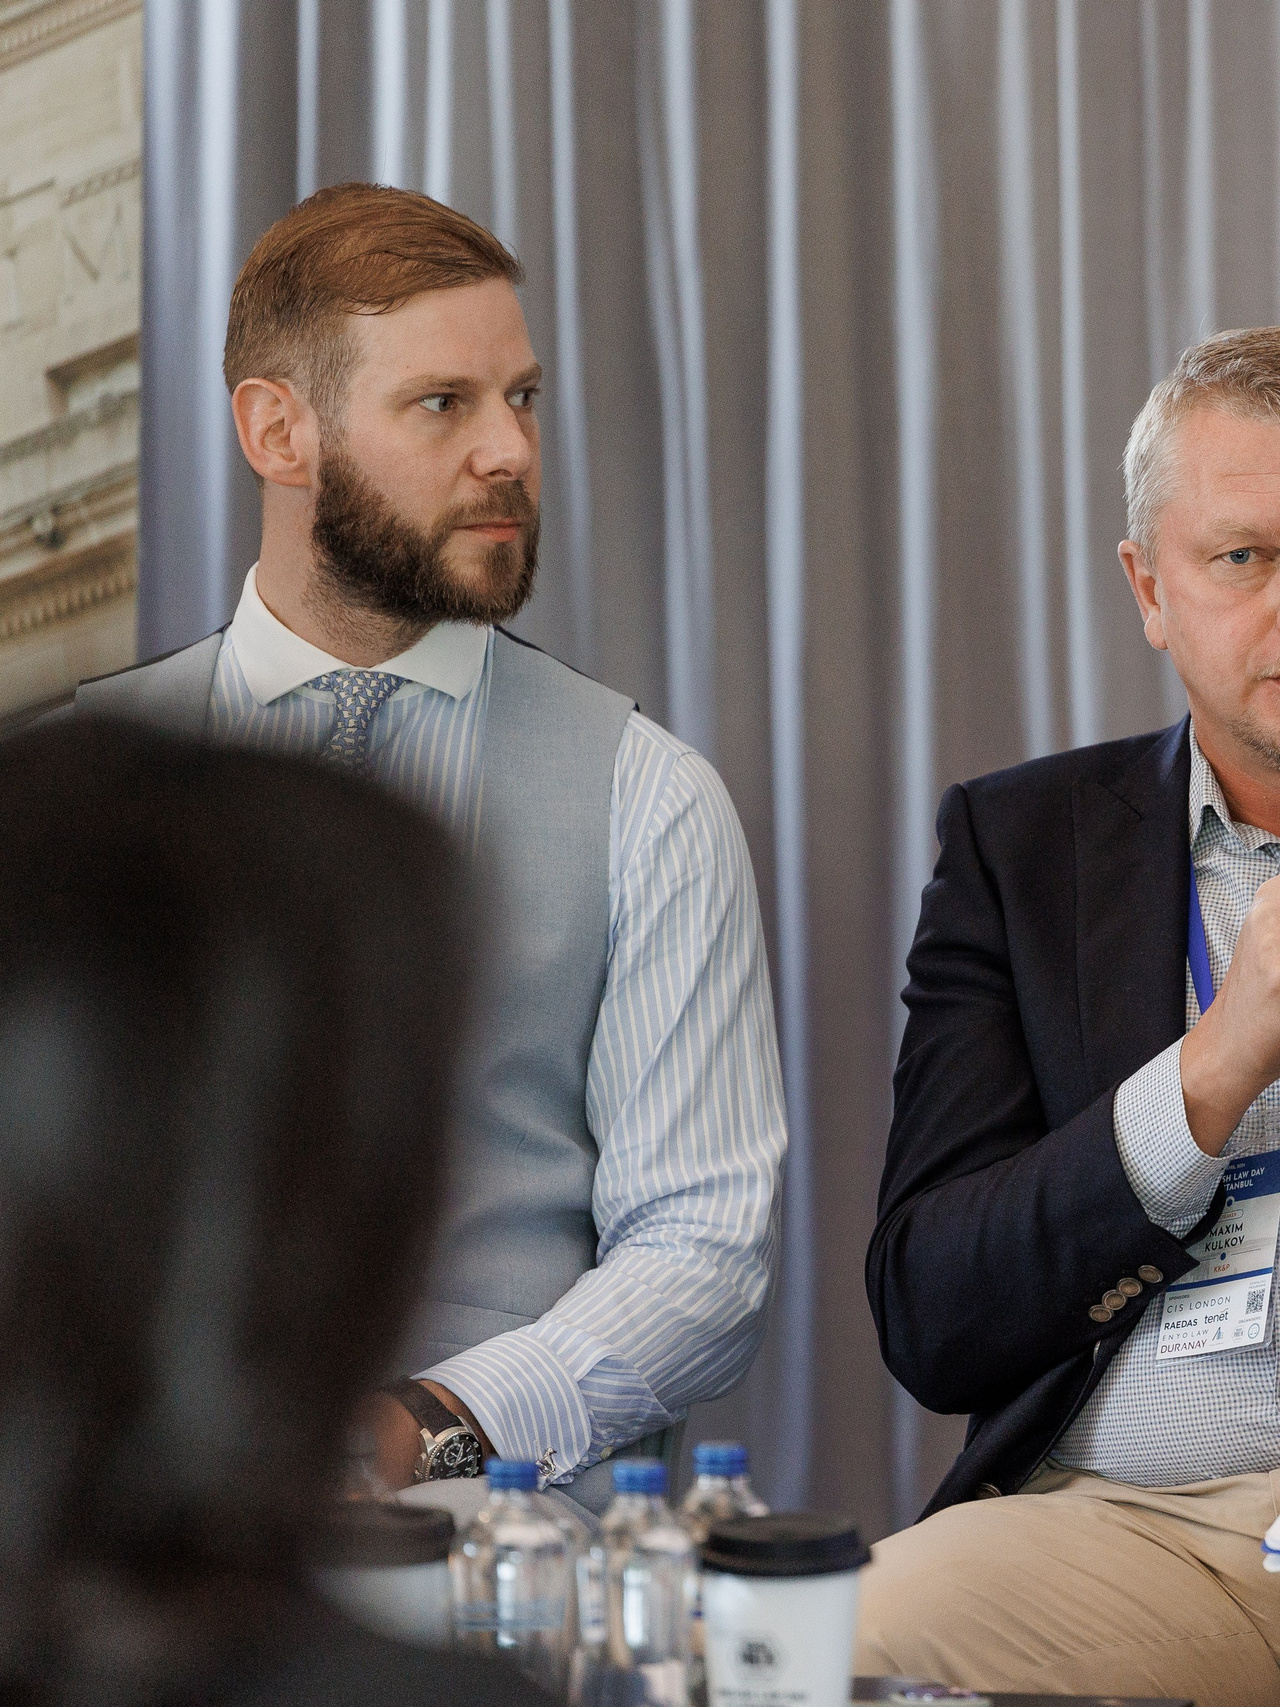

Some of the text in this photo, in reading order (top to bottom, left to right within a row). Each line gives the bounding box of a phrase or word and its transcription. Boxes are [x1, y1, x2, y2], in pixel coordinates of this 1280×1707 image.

[1233, 1170, 1250, 1181] LAW
[1250, 1166, 1266, 1177] DAY
[1223, 1179, 1254, 1191] TANBUL
[1209, 1222, 1244, 1238] MAXIM
[1204, 1235, 1246, 1253] KULKOV
[1166, 1295, 1231, 1314] CIS LONDON
[1163, 1318, 1199, 1331] RAEDAS
[1204, 1310, 1229, 1325] tenet
[1160, 1339, 1208, 1354] DURANAY
